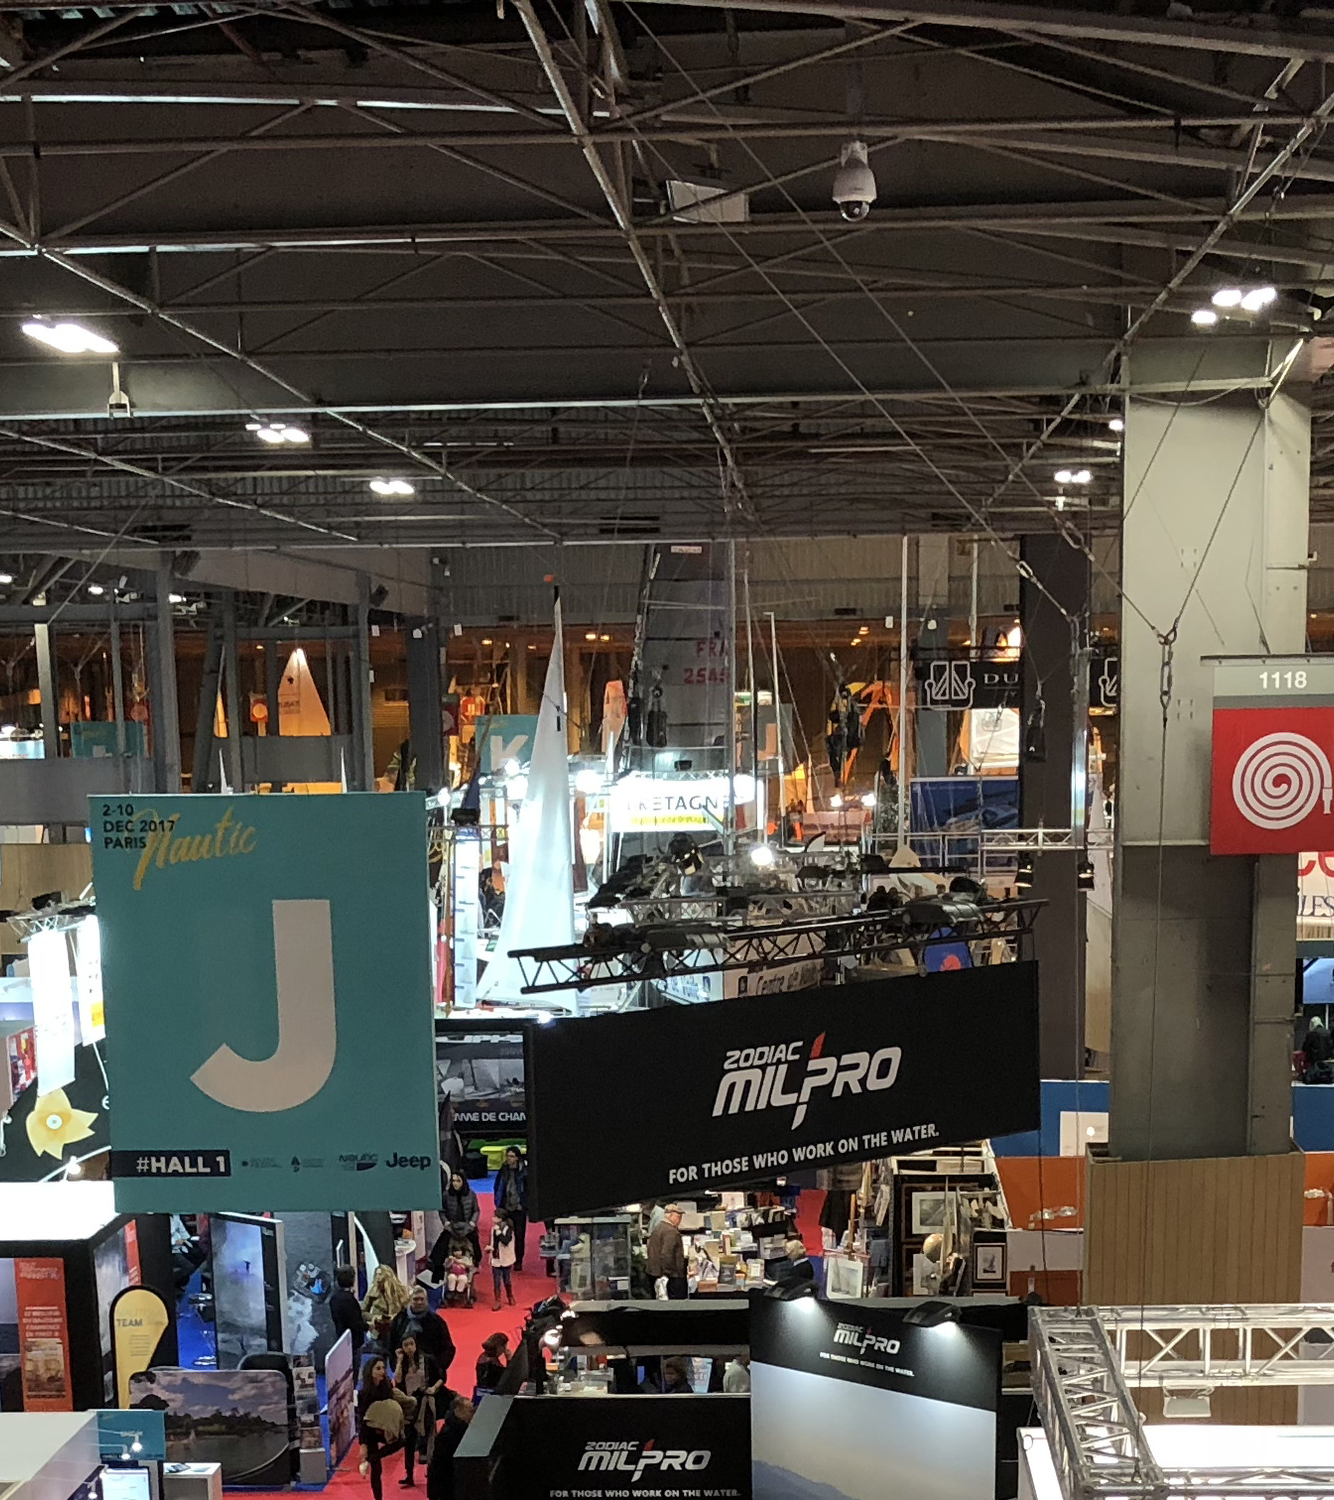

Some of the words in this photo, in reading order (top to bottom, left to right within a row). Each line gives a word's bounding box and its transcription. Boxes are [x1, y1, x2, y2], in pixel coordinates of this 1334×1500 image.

[1259, 671, 1308, 689] 1118
[102, 804, 134, 817] 2-10
[104, 820, 136, 833] DEC
[140, 819, 175, 833] 2017
[104, 836, 147, 850] PARIS
[131, 805, 258, 891] Nautic
[190, 899, 337, 1113] J
[723, 1041, 804, 1069] ZODIAC
[481, 1112, 497, 1121] DE
[668, 1165, 698, 1185] FOR
[701, 1157, 750, 1180] THOSE
[752, 1150, 789, 1172] WHO
[792, 1142, 835, 1165] WORK
[837, 1135, 859, 1155] ON
[862, 1129, 888, 1150] THE
[891, 1123, 940, 1145] WATER.
[136, 1155, 213, 1174] #HALL
[216, 1155, 227, 1173] 1
[385, 1152, 433, 1172] Jeep
[116, 1318, 143, 1327] TEAM
[585, 1441, 640, 1451] ZODIAC
[577, 1449, 713, 1483] MILPRO
[550, 1489, 570, 1498] FOR
[571, 1489, 603, 1498] THOSE
[605, 1489, 630, 1498] WHO
[632, 1489, 662, 1498] WORK
[664, 1489, 680, 1498] ON
[682, 1489, 702, 1498] THE
[703, 1489, 742, 1498] WATER.
